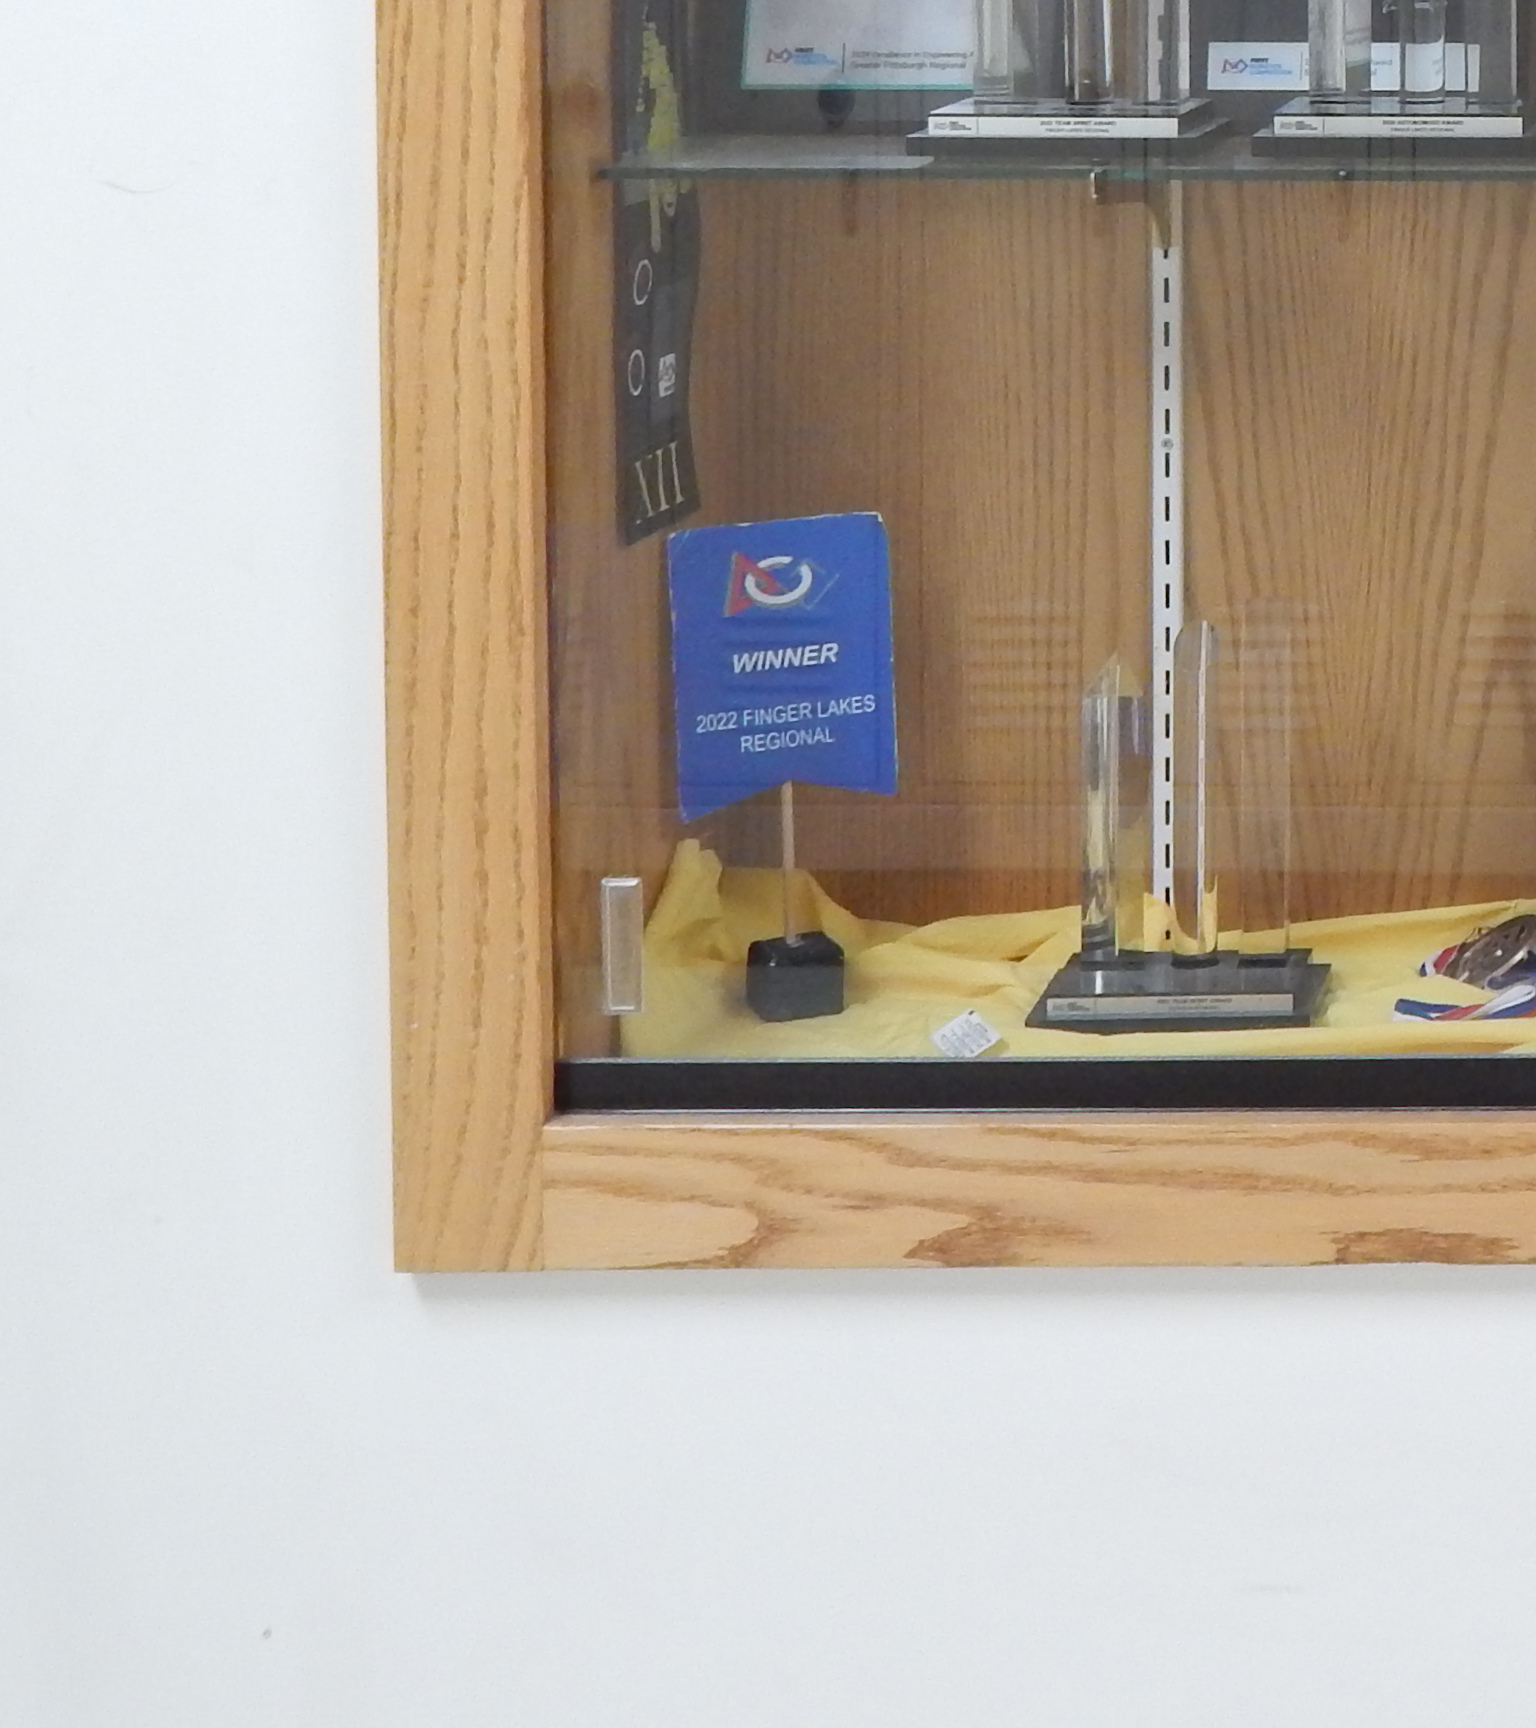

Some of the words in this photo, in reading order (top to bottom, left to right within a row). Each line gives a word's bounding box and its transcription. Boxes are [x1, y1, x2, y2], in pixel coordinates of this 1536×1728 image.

[732, 642, 840, 674] WINNER
[695, 711, 738, 735] 2022
[742, 702, 812, 730] FINGER
[817, 694, 876, 719] LAKES
[740, 725, 836, 754] REGIONAL
